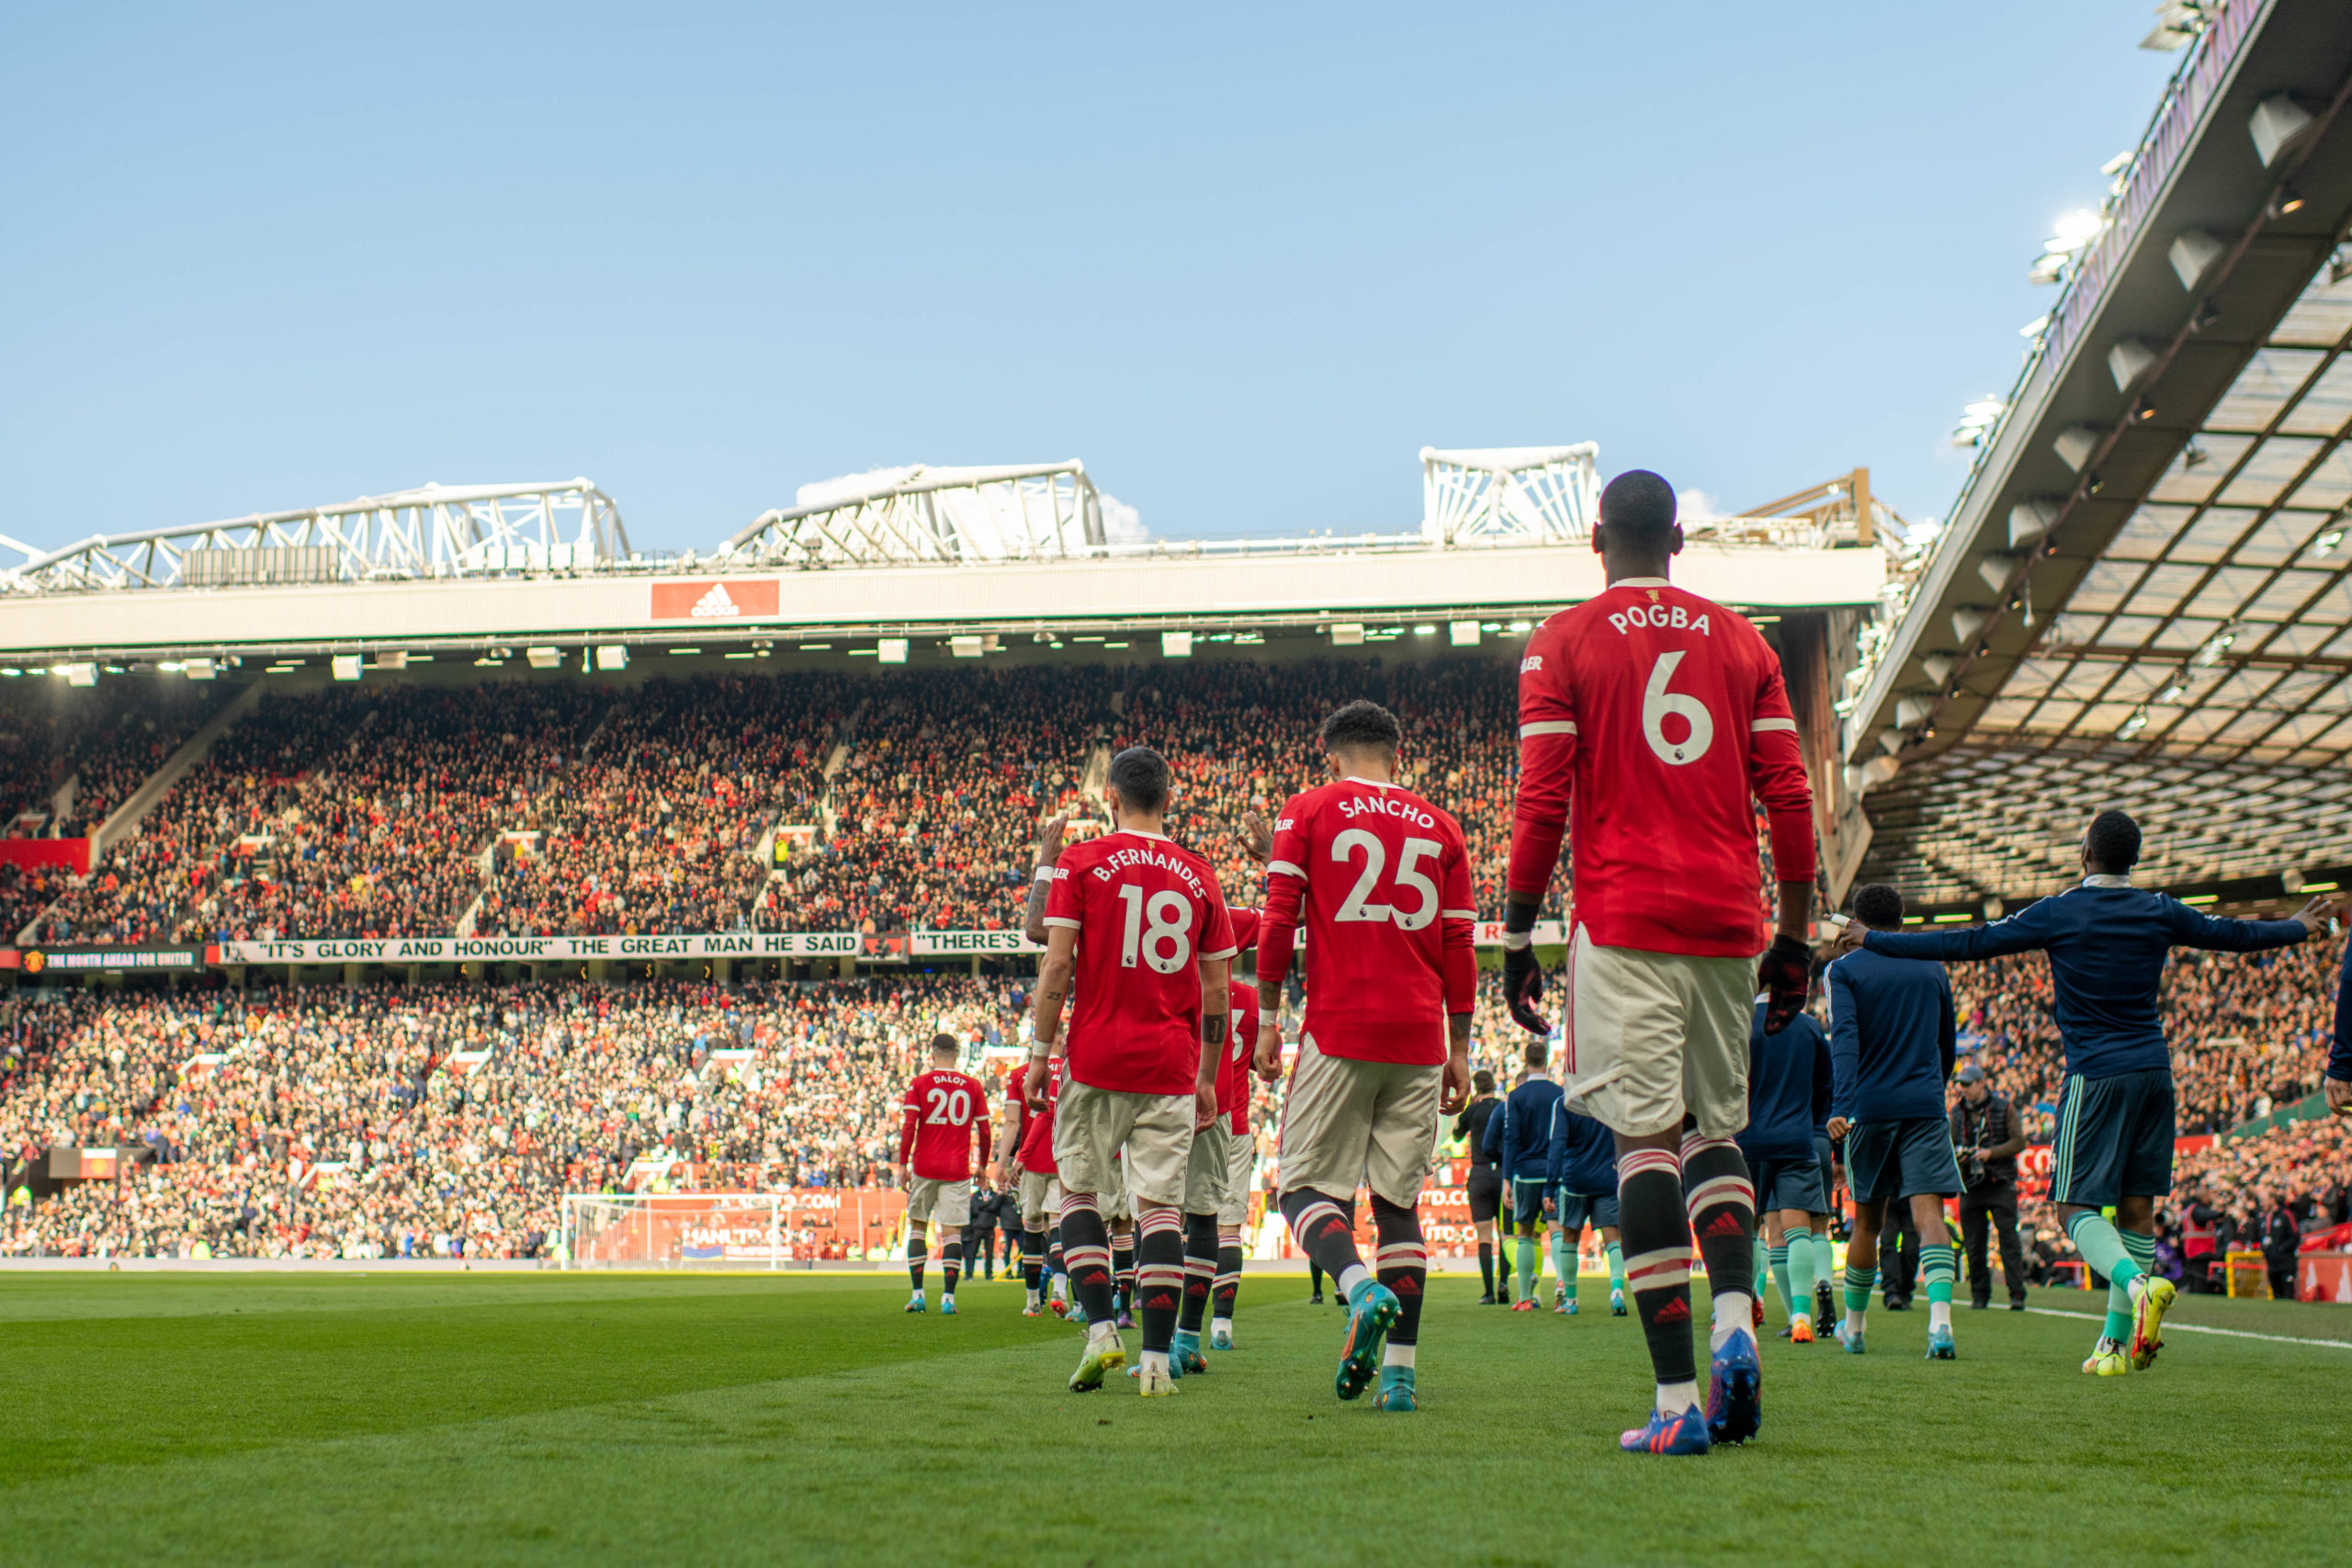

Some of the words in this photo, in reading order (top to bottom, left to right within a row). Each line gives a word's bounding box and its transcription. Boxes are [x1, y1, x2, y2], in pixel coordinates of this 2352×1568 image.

[1608, 604, 1710, 637] POGBA
[1642, 650, 1714, 766] 6
[1338, 796, 1435, 829] SANCHO
[1092, 848, 1206, 899] B.FERNANDES
[1331, 828, 1443, 931] 25
[917, 933, 1020, 949] "THERE'S
[1118, 884, 1193, 975] 18
[47, 953, 67, 968] THE
[66, 953, 103, 967] MONTH
[103, 953, 135, 967] AHEAD
[136, 952, 156, 966] FOR
[156, 951, 194, 966] UNITED
[259, 943, 305, 958] "IT'S
[317, 942, 387, 957] GLORY
[399, 941, 443, 956] AND
[454, 940, 553, 955] HONOUR"
[568, 939, 610, 953] THE
[620, 938, 692, 953] GREAT
[704, 937, 754, 952] MAN
[764, 936, 794, 951] HE
[805, 936, 856, 950] SAID
[933, 1075, 967, 1087] DALOT
[925, 1088, 971, 1126] 20
